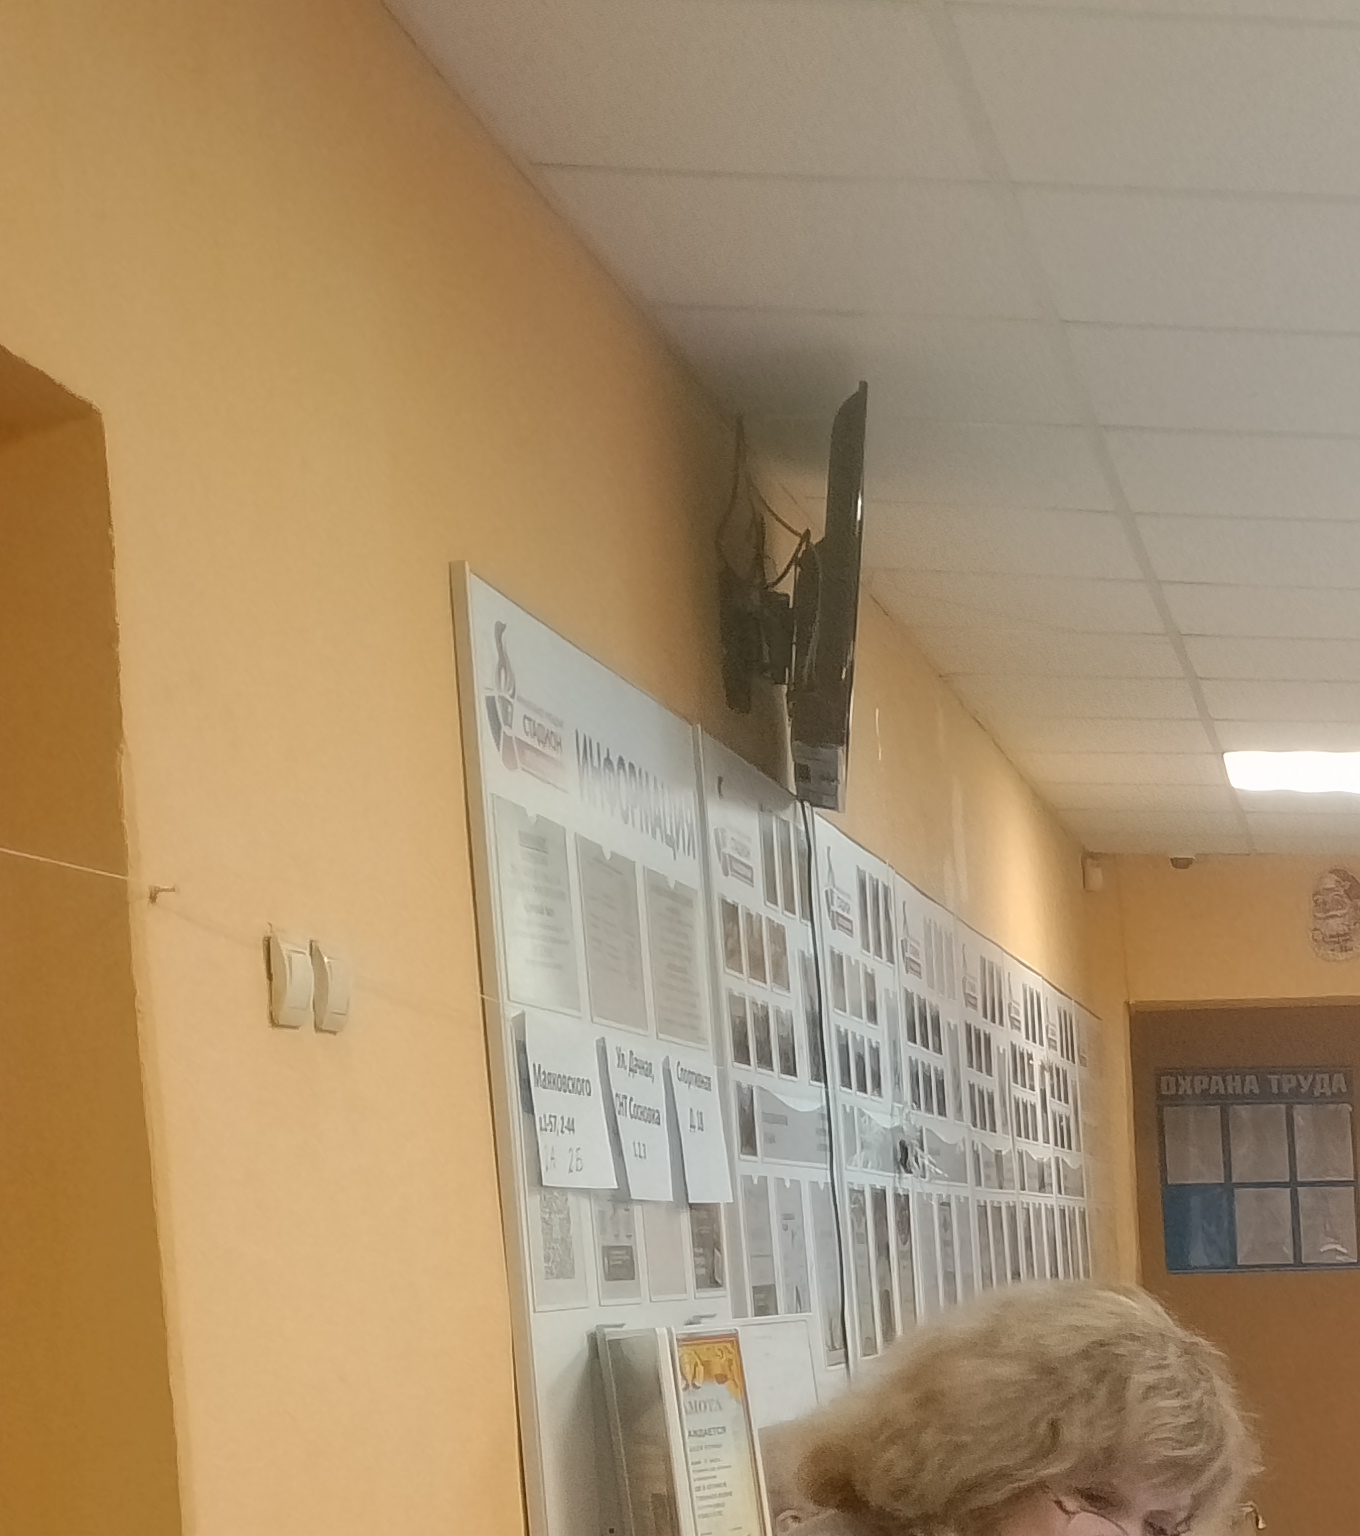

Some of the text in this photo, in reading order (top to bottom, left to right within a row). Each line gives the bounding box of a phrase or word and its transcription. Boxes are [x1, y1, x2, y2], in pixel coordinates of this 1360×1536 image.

[532, 1062, 592, 1097] Маяковского
[1160, 1072, 1348, 1097] ОХРАНА ТРУДА
